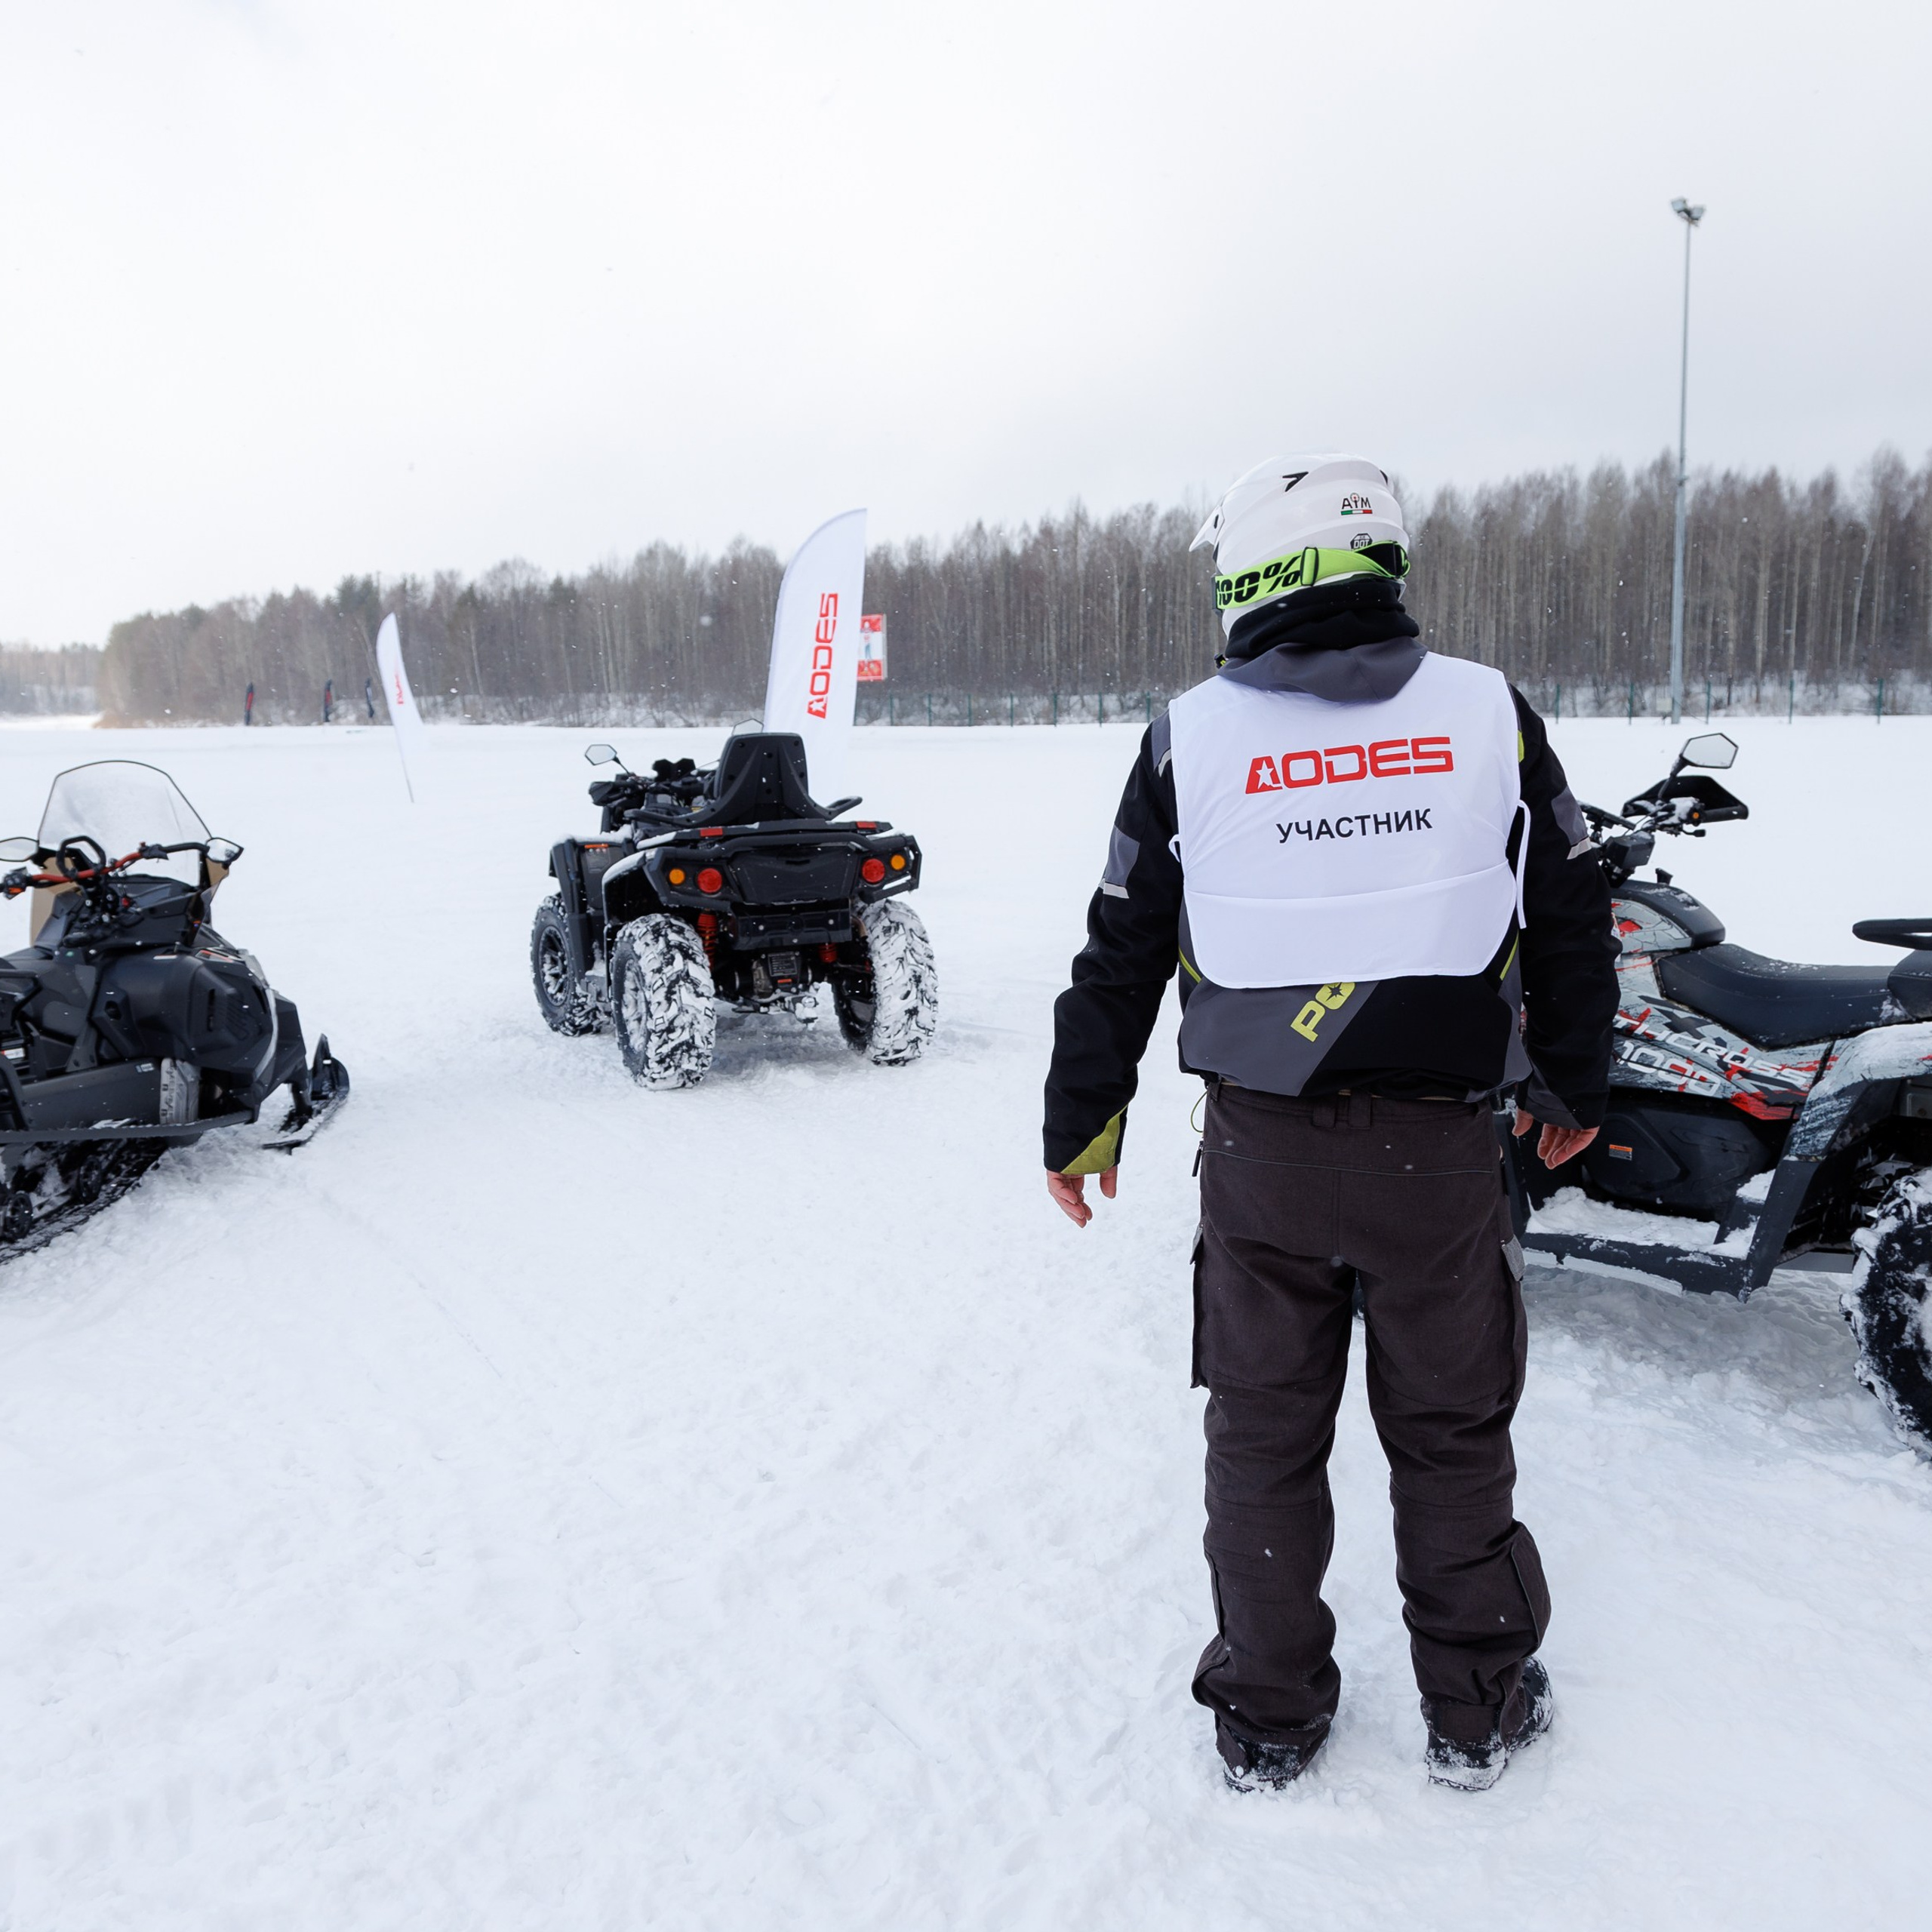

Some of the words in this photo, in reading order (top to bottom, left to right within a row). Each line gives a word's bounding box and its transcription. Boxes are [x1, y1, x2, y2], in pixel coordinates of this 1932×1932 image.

[807, 592, 838, 718] AODES
[1245, 737, 1454, 794] AODES
[1275, 808, 1433, 844] УЧАСТНИК
[1616, 1040, 1722, 1097] 1000
